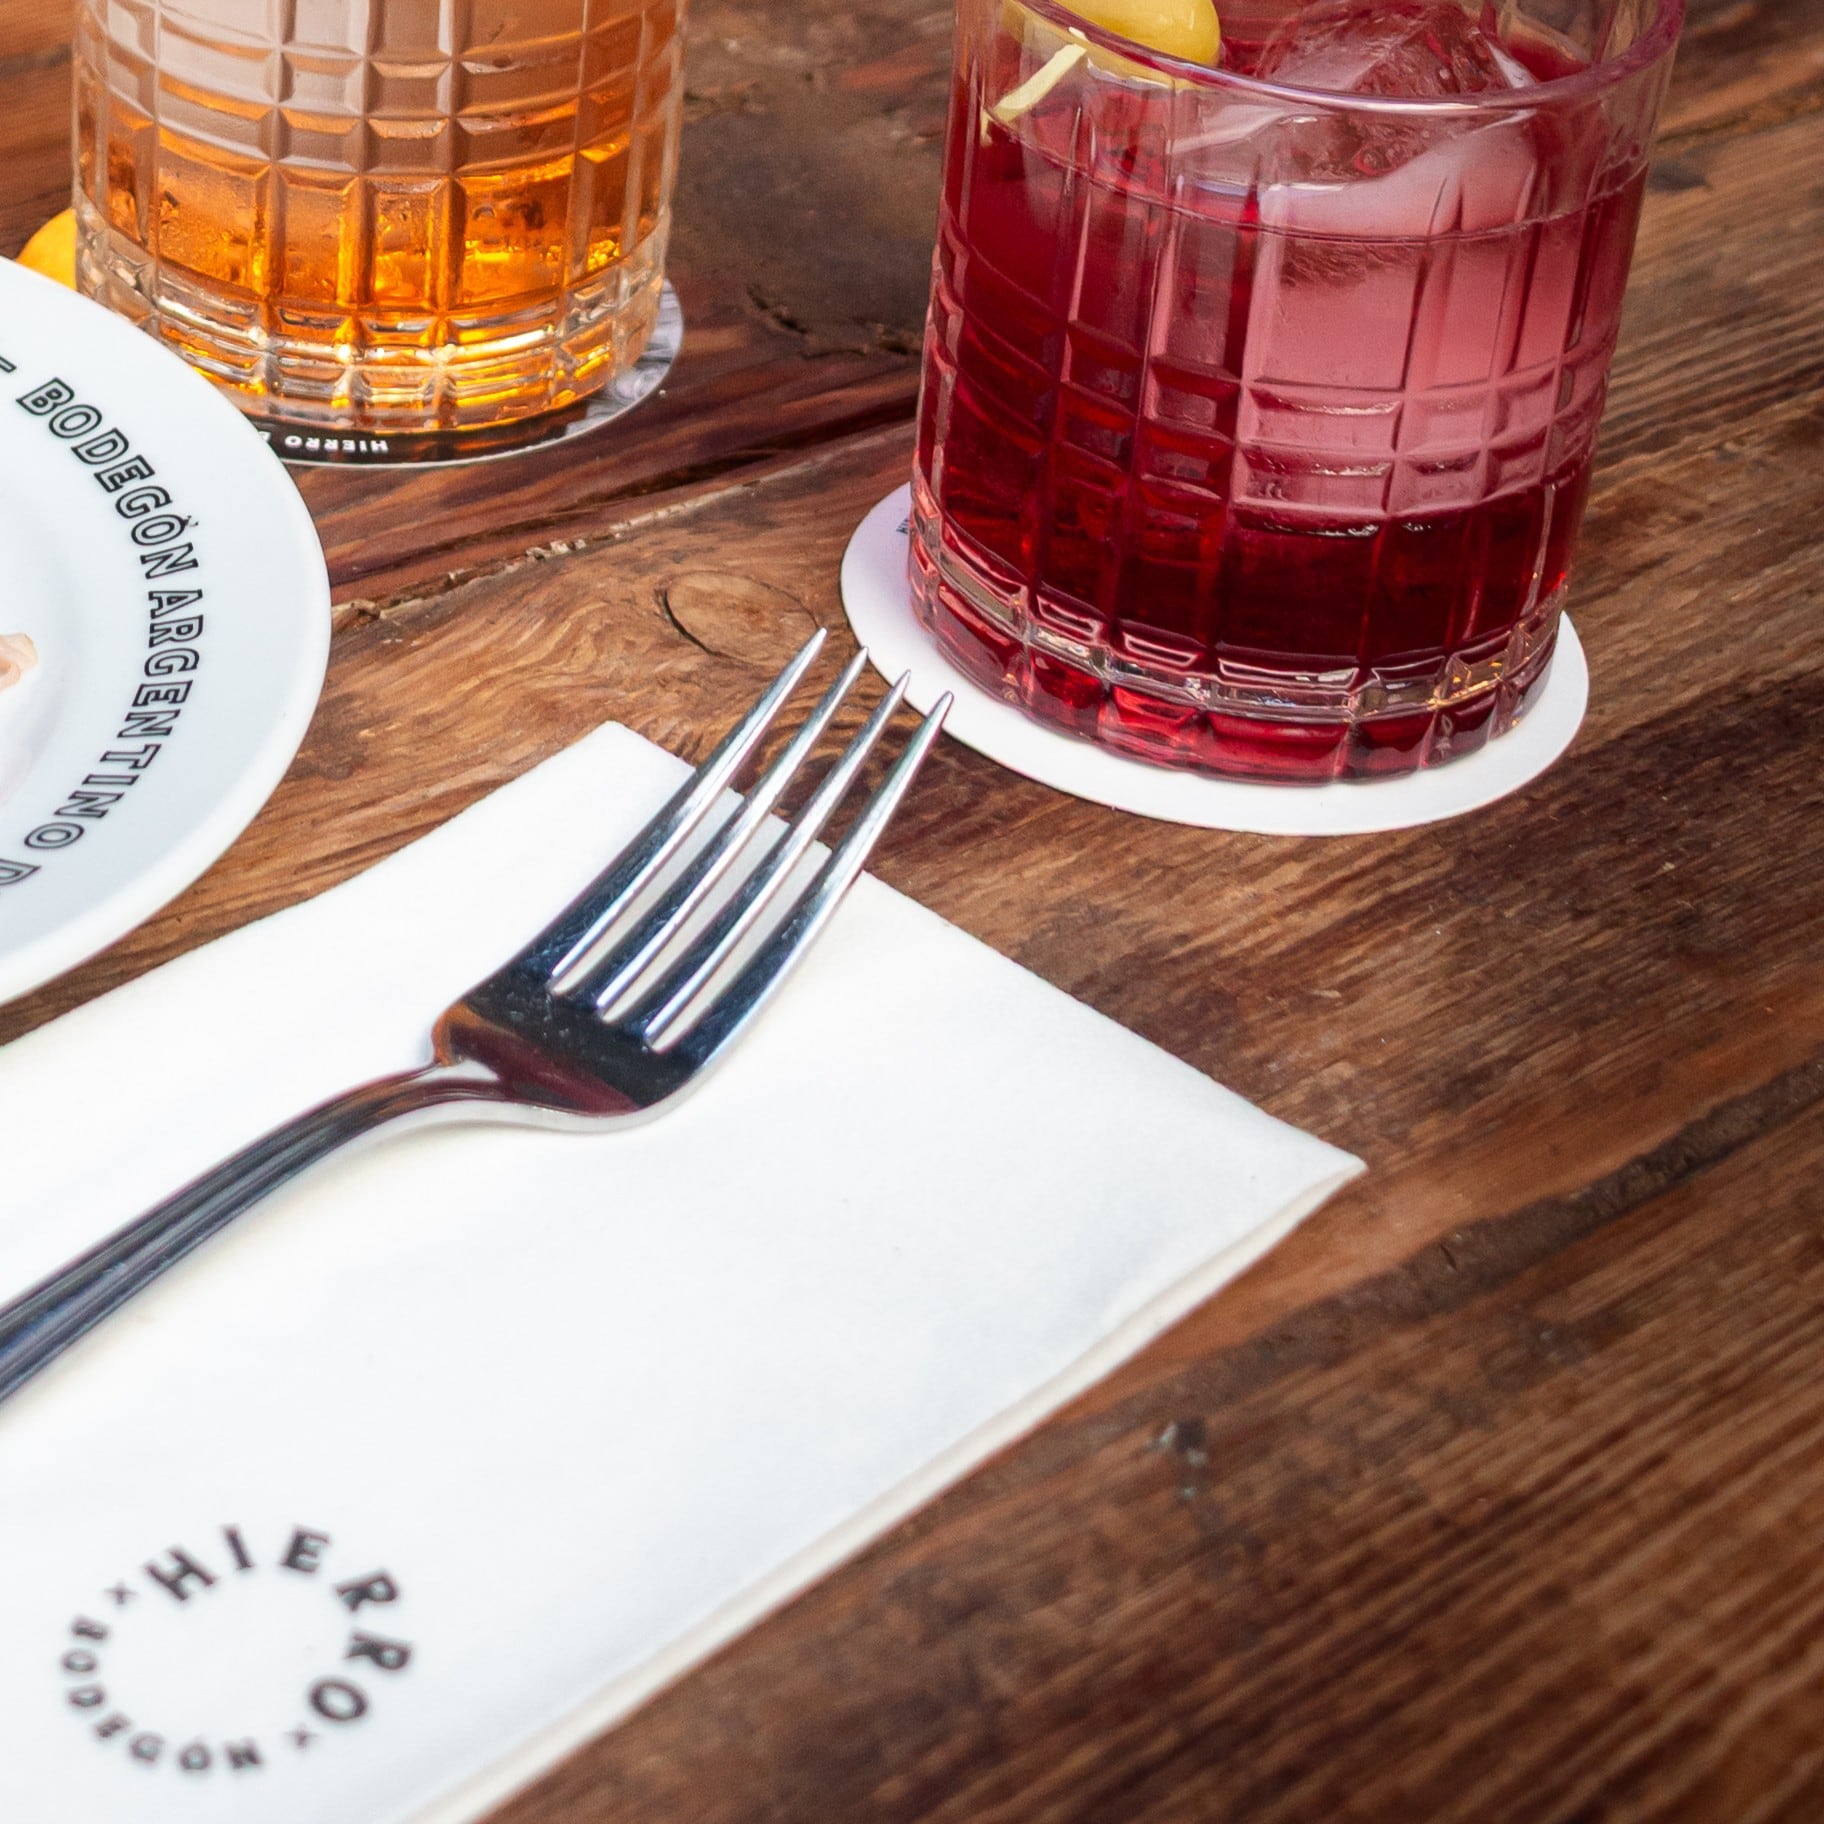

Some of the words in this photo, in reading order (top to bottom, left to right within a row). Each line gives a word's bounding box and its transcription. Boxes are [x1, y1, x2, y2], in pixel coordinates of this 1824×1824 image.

[283, 434, 389, 454] HIERRO
[23, 588, 205, 851] ARGENTINO
[144, 1526, 413, 1723] HIERRO
